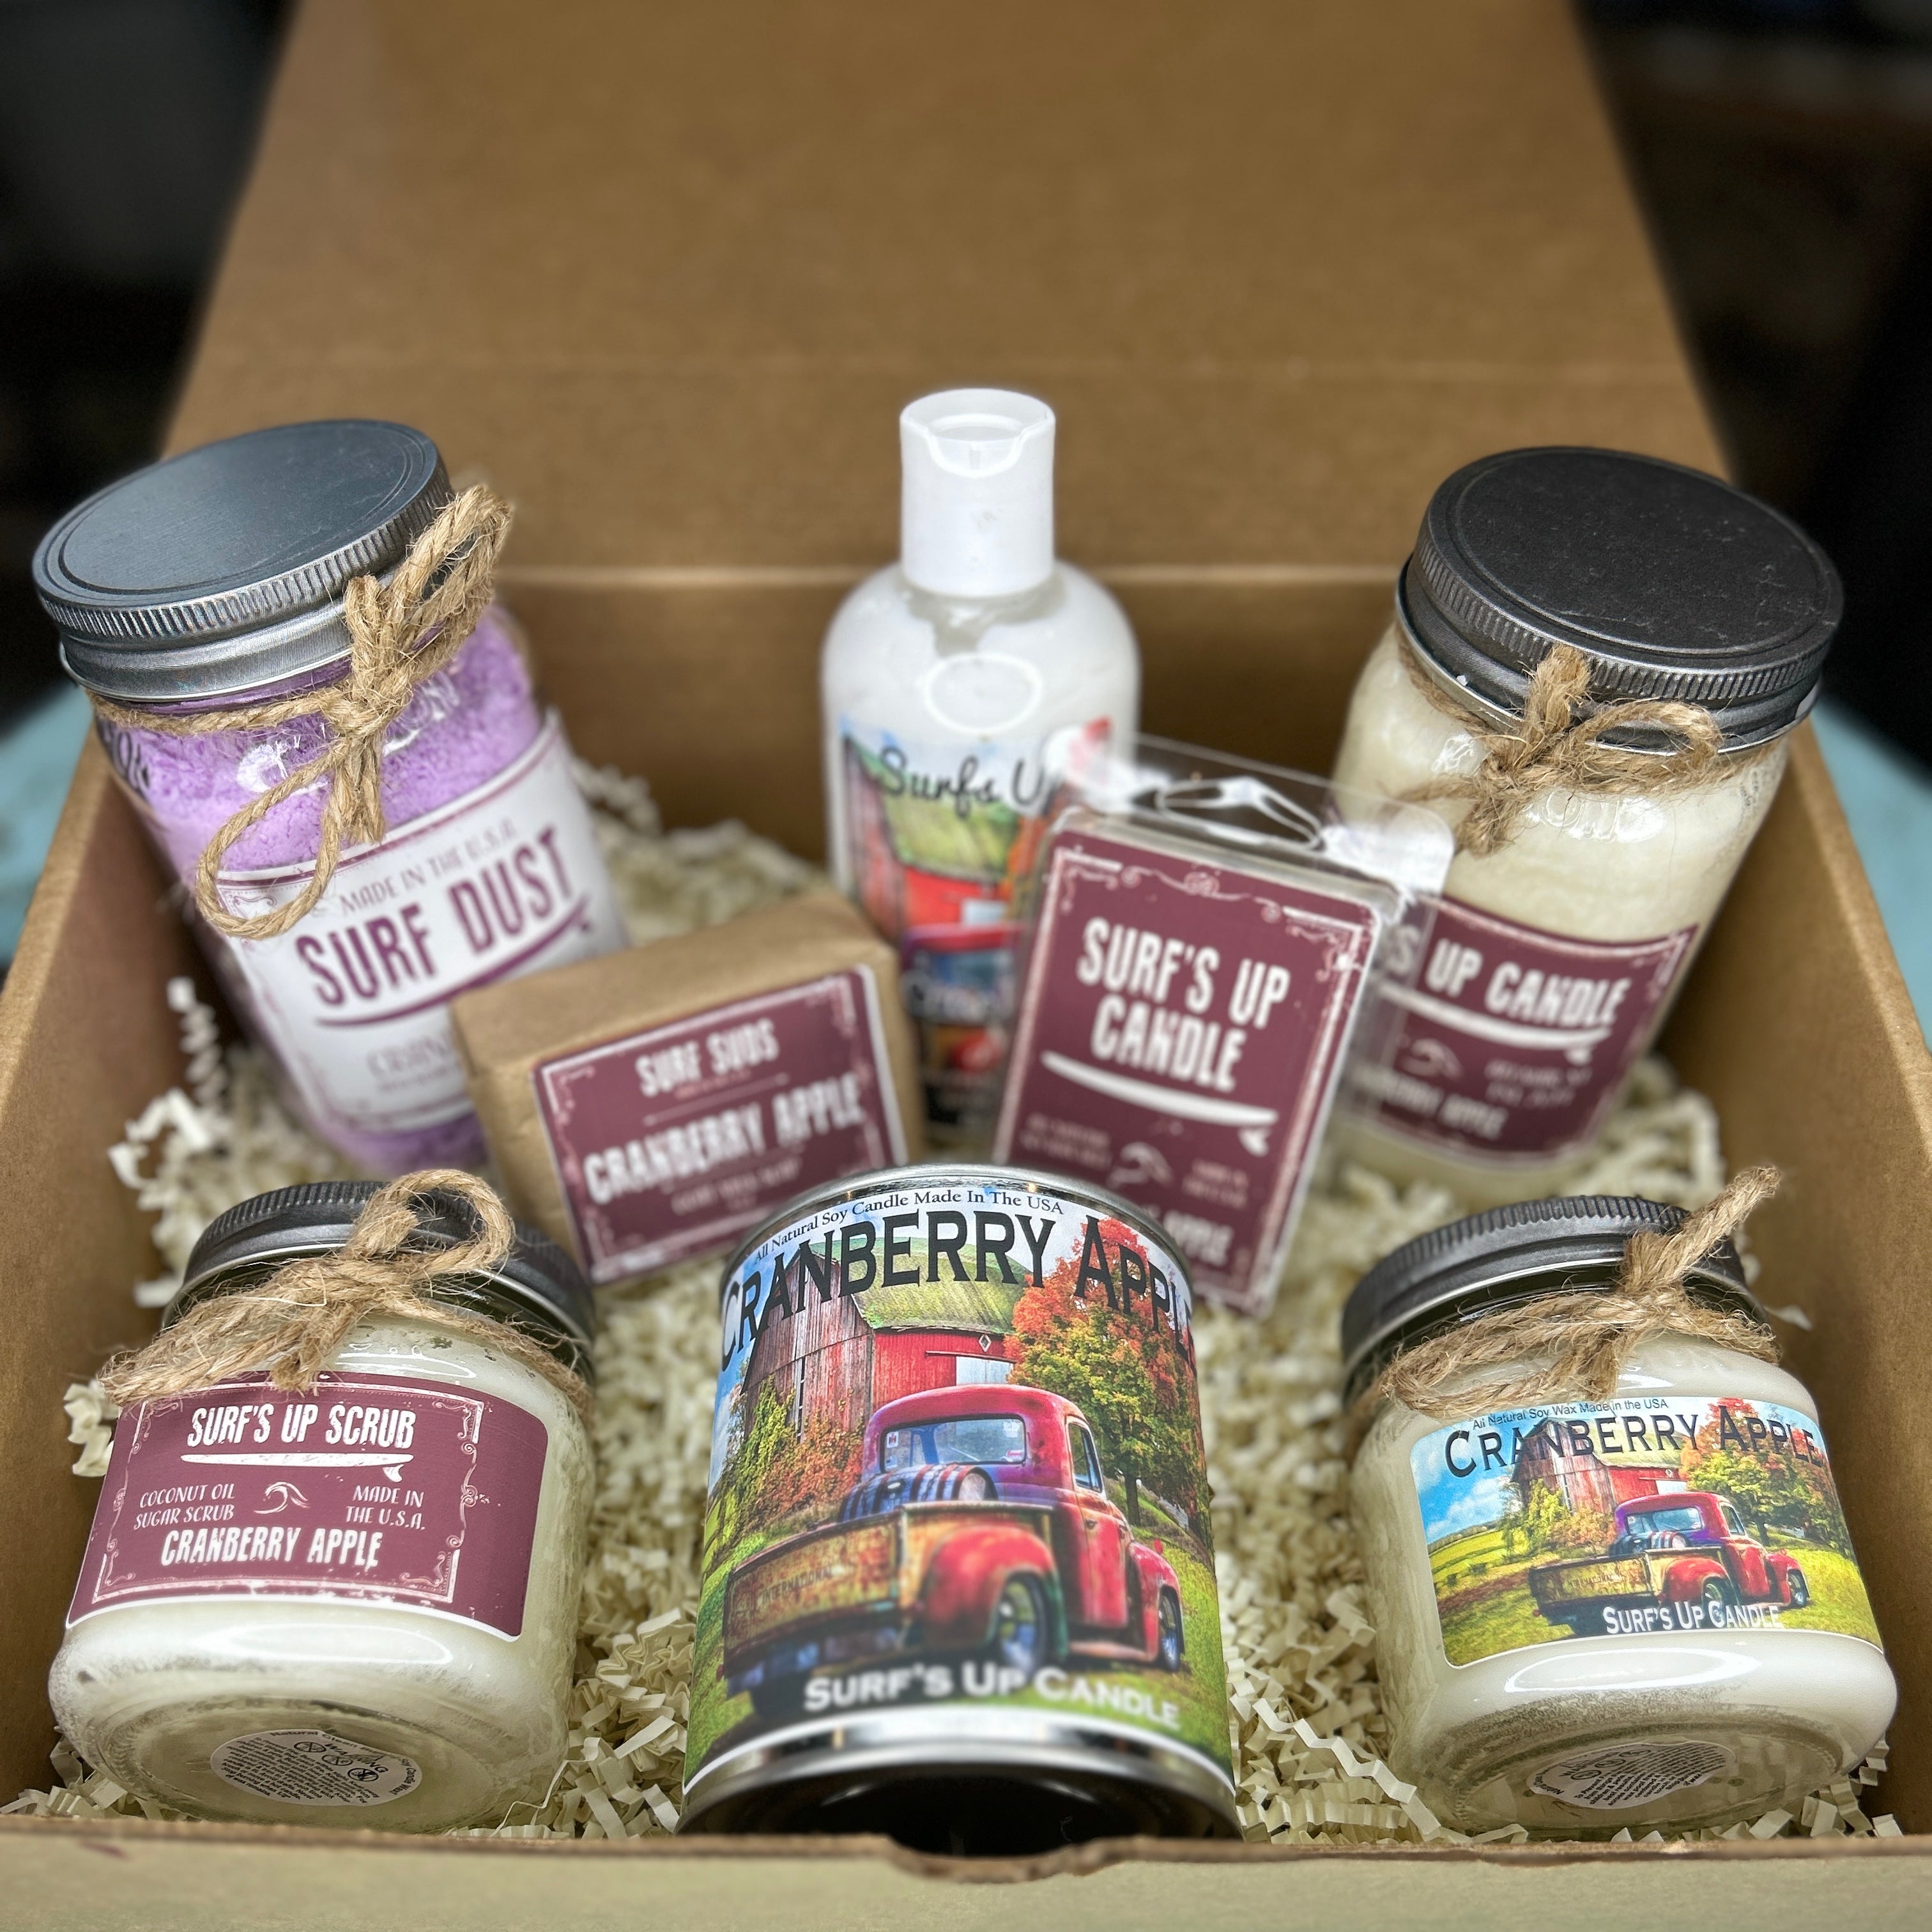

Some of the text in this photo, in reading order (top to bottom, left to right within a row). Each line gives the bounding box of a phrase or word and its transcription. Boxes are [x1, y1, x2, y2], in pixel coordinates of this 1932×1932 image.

[1010, 758, 1044, 806] U
[296, 829, 575, 1006] SURF DUST
[1076, 916, 1220, 1015] SURF'S
[1228, 959, 1291, 1030] UP
[1423, 938, 1483, 997] UP
[1485, 960, 1631, 1027] CANDLE
[636, 1039, 703, 1096] SURF
[706, 1019, 779, 1076] SUDS
[1090, 994, 1246, 1092] CANDLE
[583, 1102, 765, 1205] CRANBERRY
[771, 1072, 864, 1149] APPLE
[754, 1190, 1064, 1264] All Natural Soy Candle Made In The USA
[722, 1210, 1056, 1372] CRANBERRY
[187, 1403, 417, 1449] SURF'S UP SCRUB
[1445, 1405, 1825, 1478] CRANBERRY APPLE
[1488, 1411, 1527, 1427] Natural
[1552, 1406, 1577, 1416] Wax
[1579, 1402, 1609, 1414] Made
[1611, 1400, 1621, 1411] in
[1623, 1399, 1641, 1411] the
[1644, 1398, 1669, 1409] USA
[134, 1504, 235, 1529] SUGAR SCRUB
[140, 1483, 235, 1508] COCONUT OIL
[346, 1505, 426, 1531] THE U.S.A.
[353, 1485, 425, 1508] MADE IN
[161, 1526, 383, 1570] CRANBERRY APPLE
[1603, 1600, 1783, 1634] SURF'S UP CANDLE
[804, 1662, 1181, 1729] SURF'S UP CANDLE
